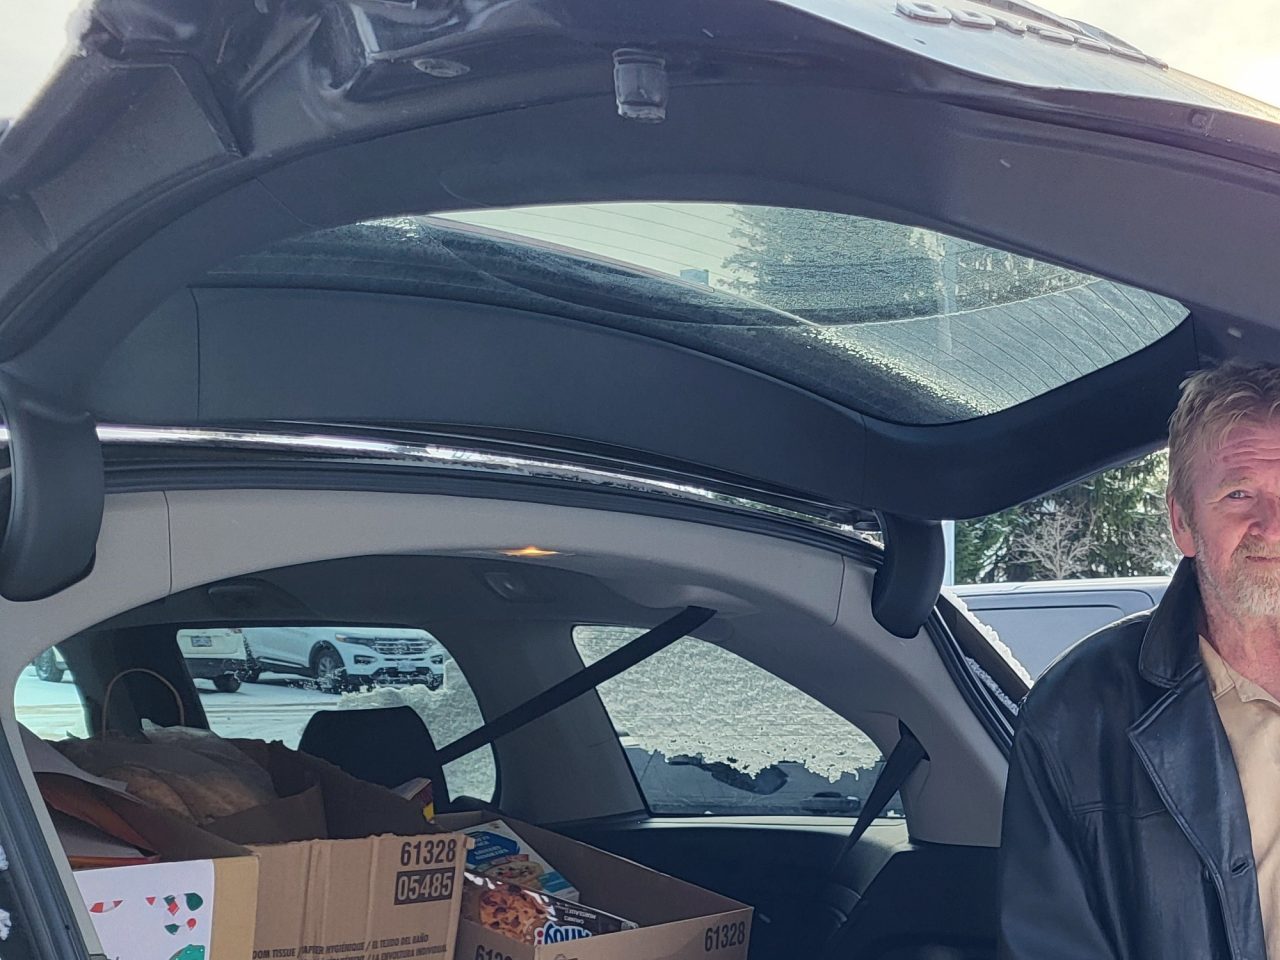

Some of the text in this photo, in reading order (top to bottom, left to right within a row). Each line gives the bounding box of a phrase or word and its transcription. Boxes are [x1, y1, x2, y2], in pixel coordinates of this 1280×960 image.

[400, 838, 457, 867] 61328
[397, 872, 452, 900] 05485
[704, 921, 746, 952] 61328
